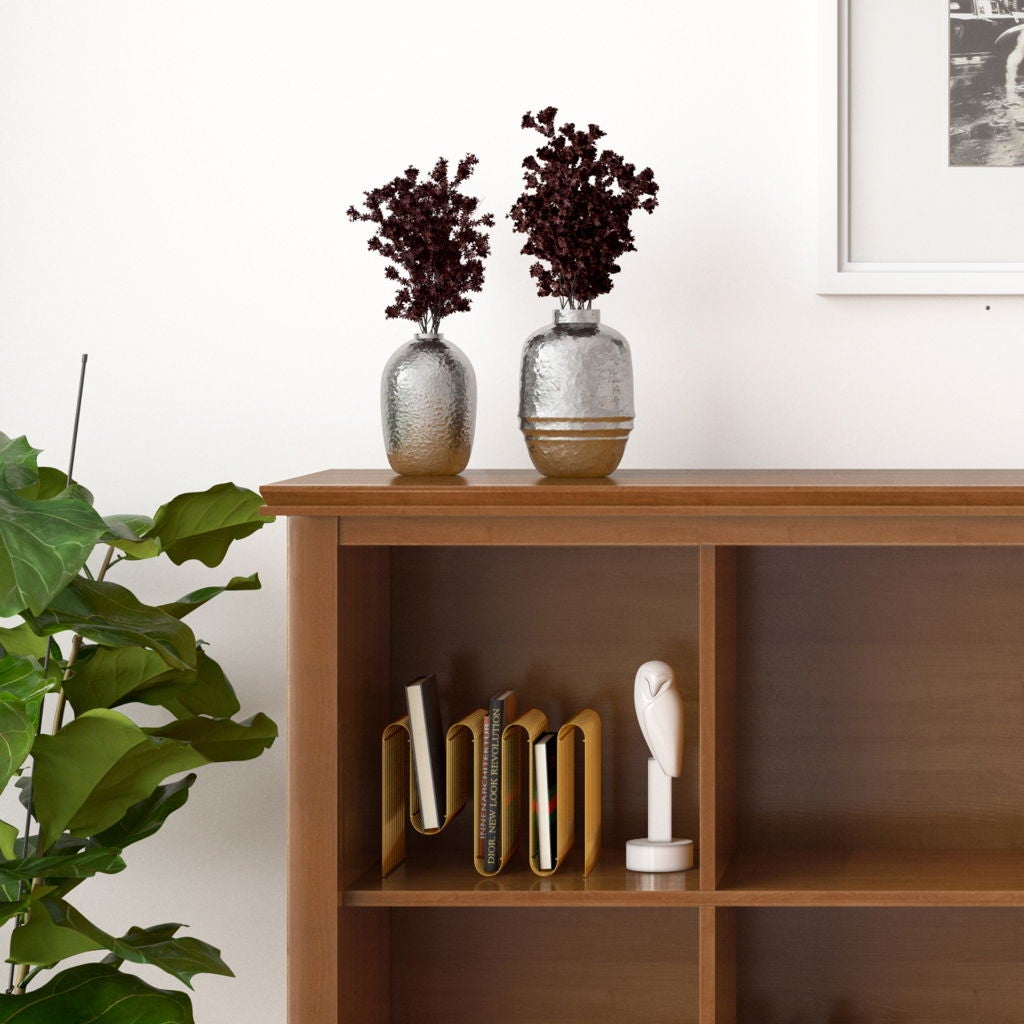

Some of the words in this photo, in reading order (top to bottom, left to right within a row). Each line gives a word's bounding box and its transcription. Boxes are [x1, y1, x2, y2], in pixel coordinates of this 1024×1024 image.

[491, 708, 500, 775] REVOLUTION
[490, 777, 498, 806] LOOK
[489, 809, 497, 834] NEW
[487, 836, 496, 865] DIOR.
